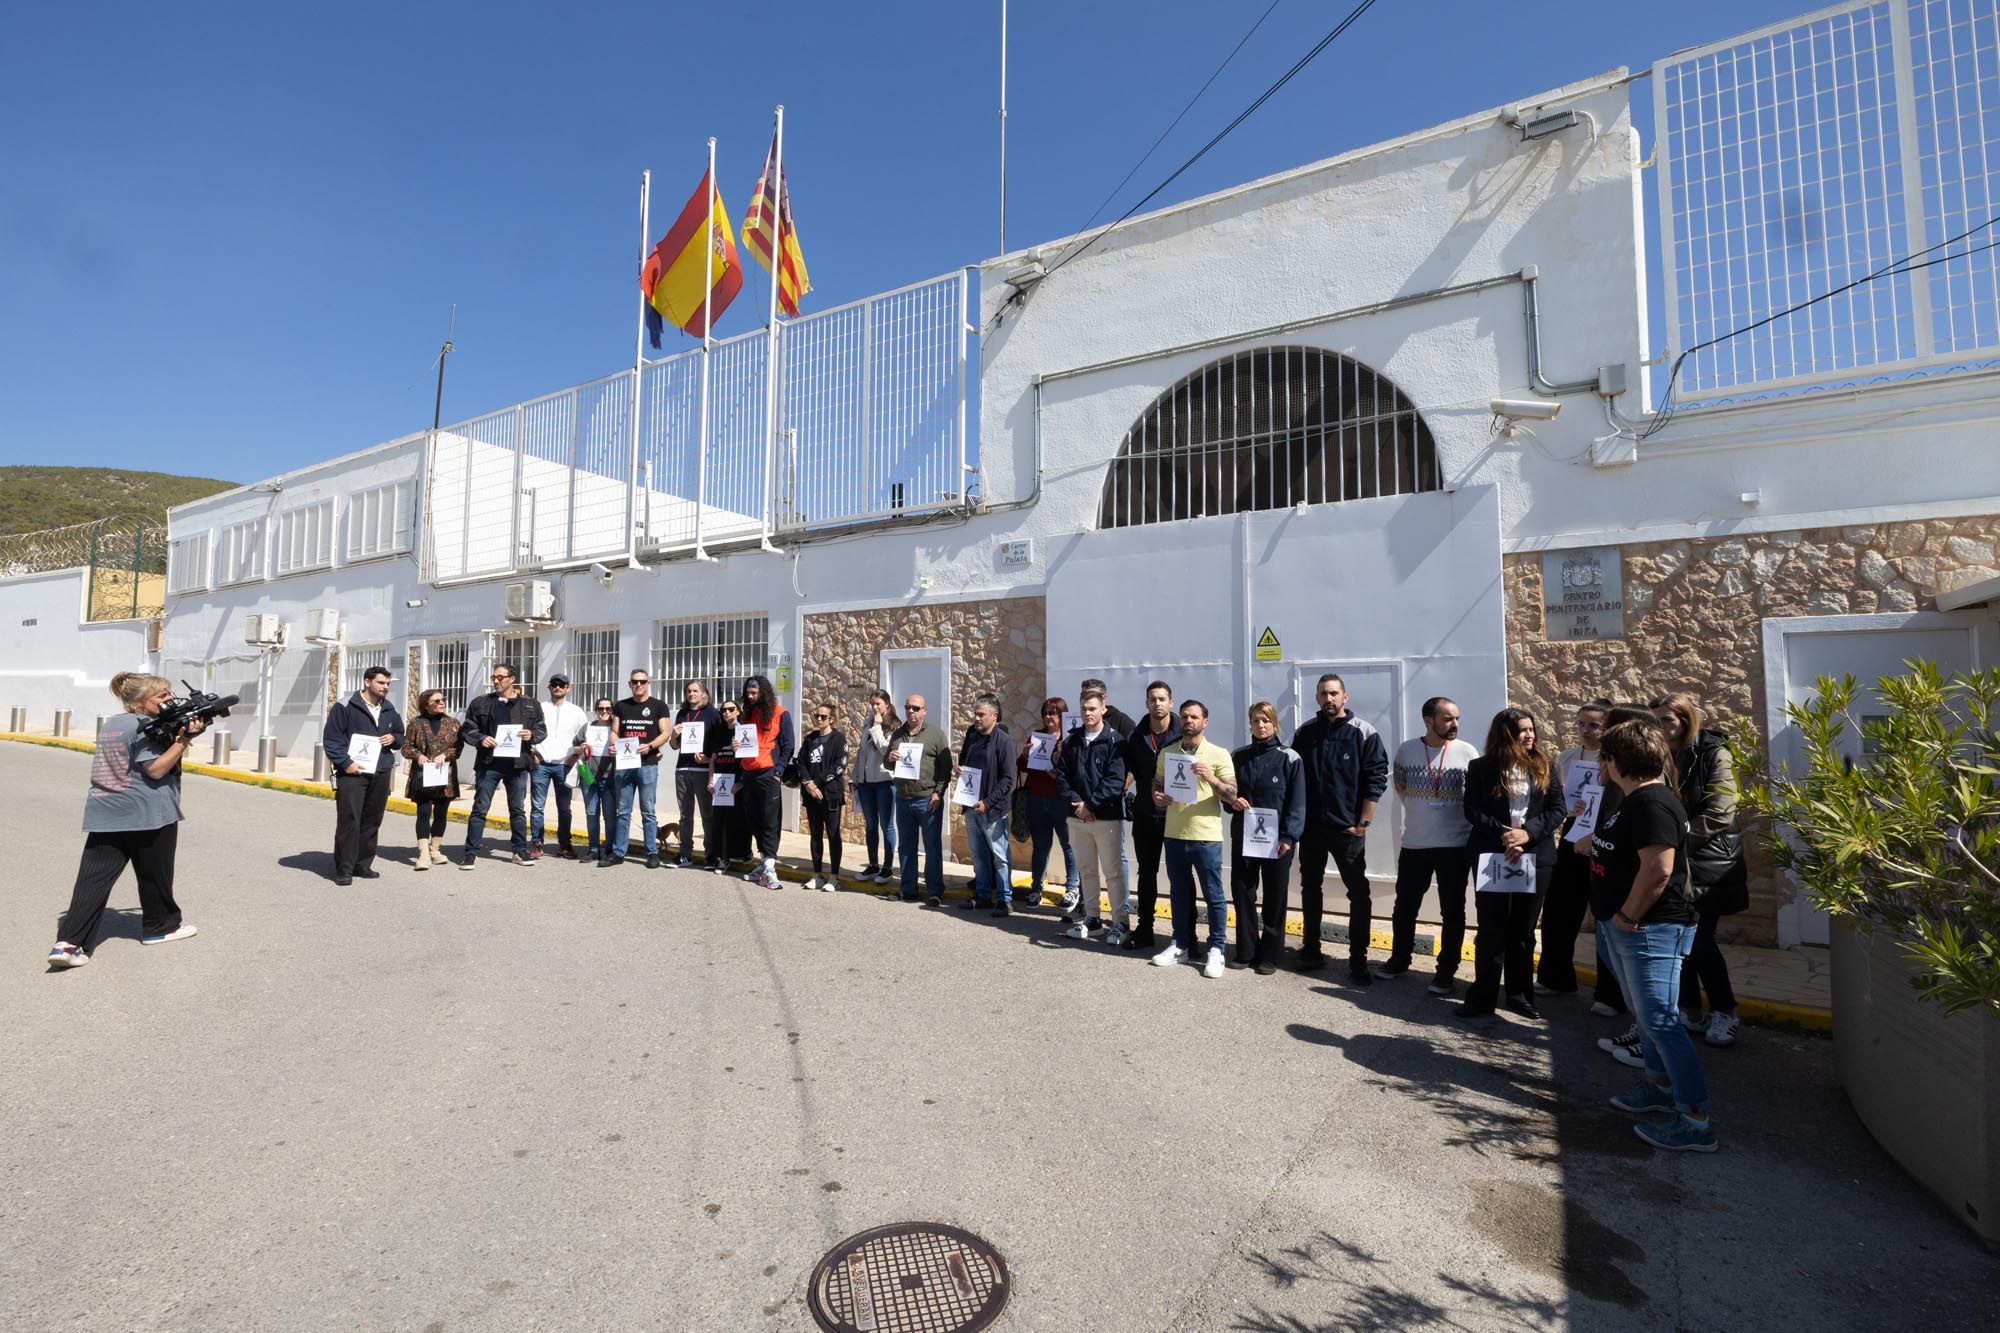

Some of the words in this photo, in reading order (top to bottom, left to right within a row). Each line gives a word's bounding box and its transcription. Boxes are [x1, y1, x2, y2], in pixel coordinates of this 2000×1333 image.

[1563, 591, 1601, 602] CENTRO
[1546, 601, 1622, 614] PENITENCIARIO
[1576, 615, 1590, 625] DE
[1569, 627, 1599, 638] IBIZA
